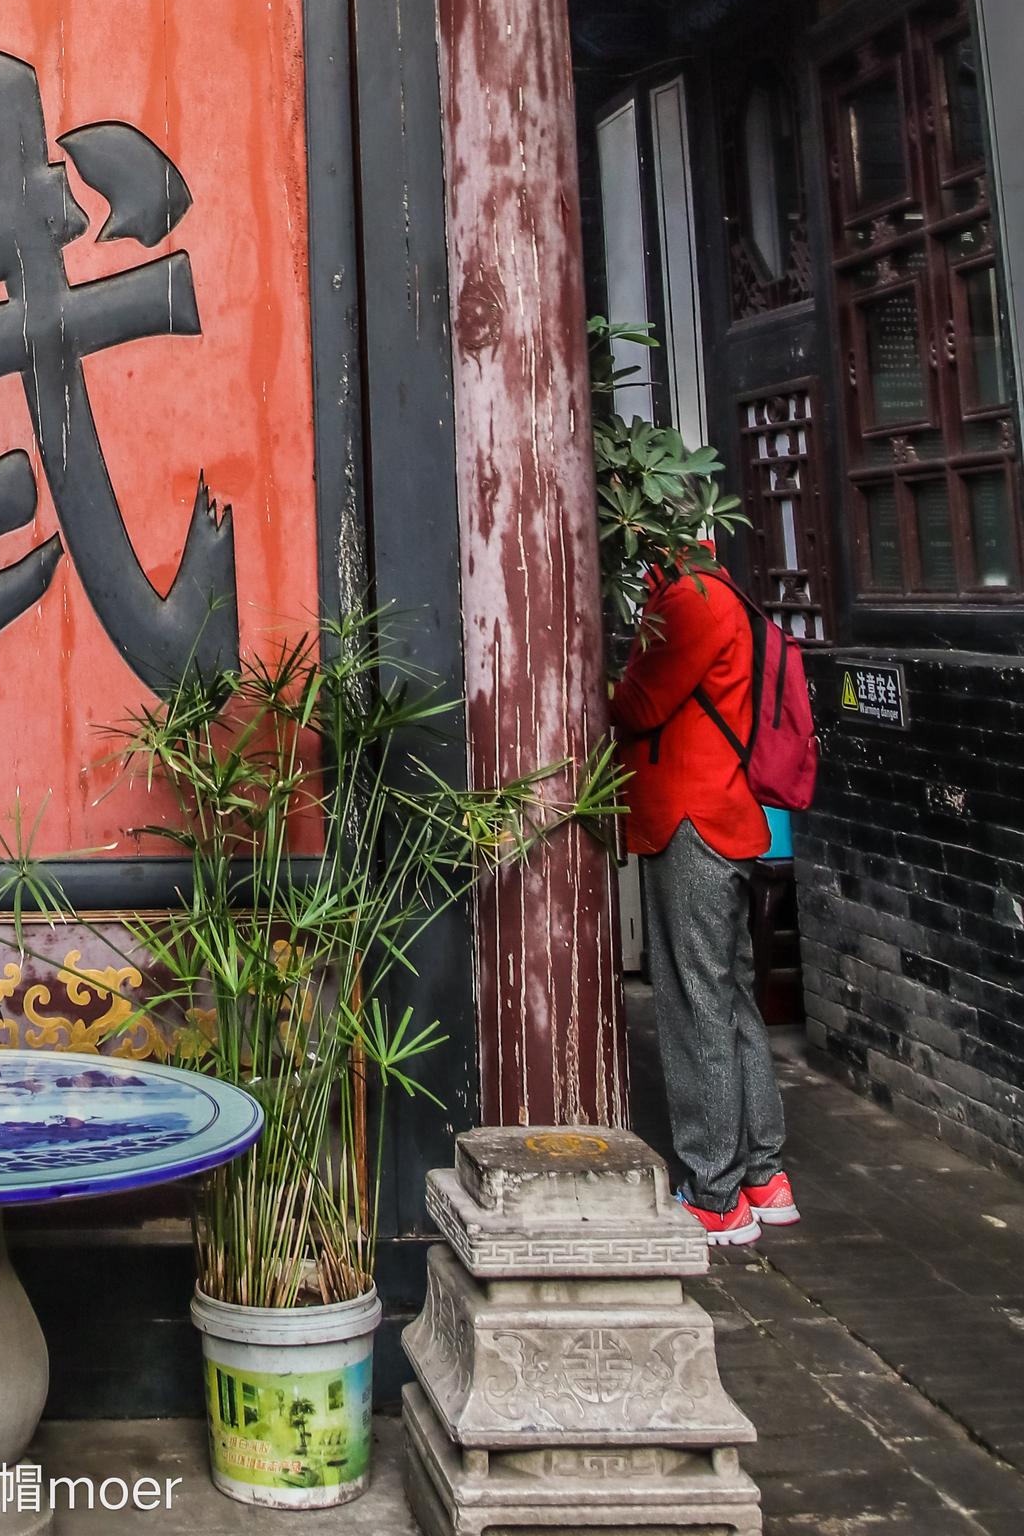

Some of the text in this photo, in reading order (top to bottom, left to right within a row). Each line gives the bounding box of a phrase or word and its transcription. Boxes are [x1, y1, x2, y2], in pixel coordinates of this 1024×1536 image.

[856, 671, 897, 704] 注意安全
[859, 702, 899, 721] Warning danger
